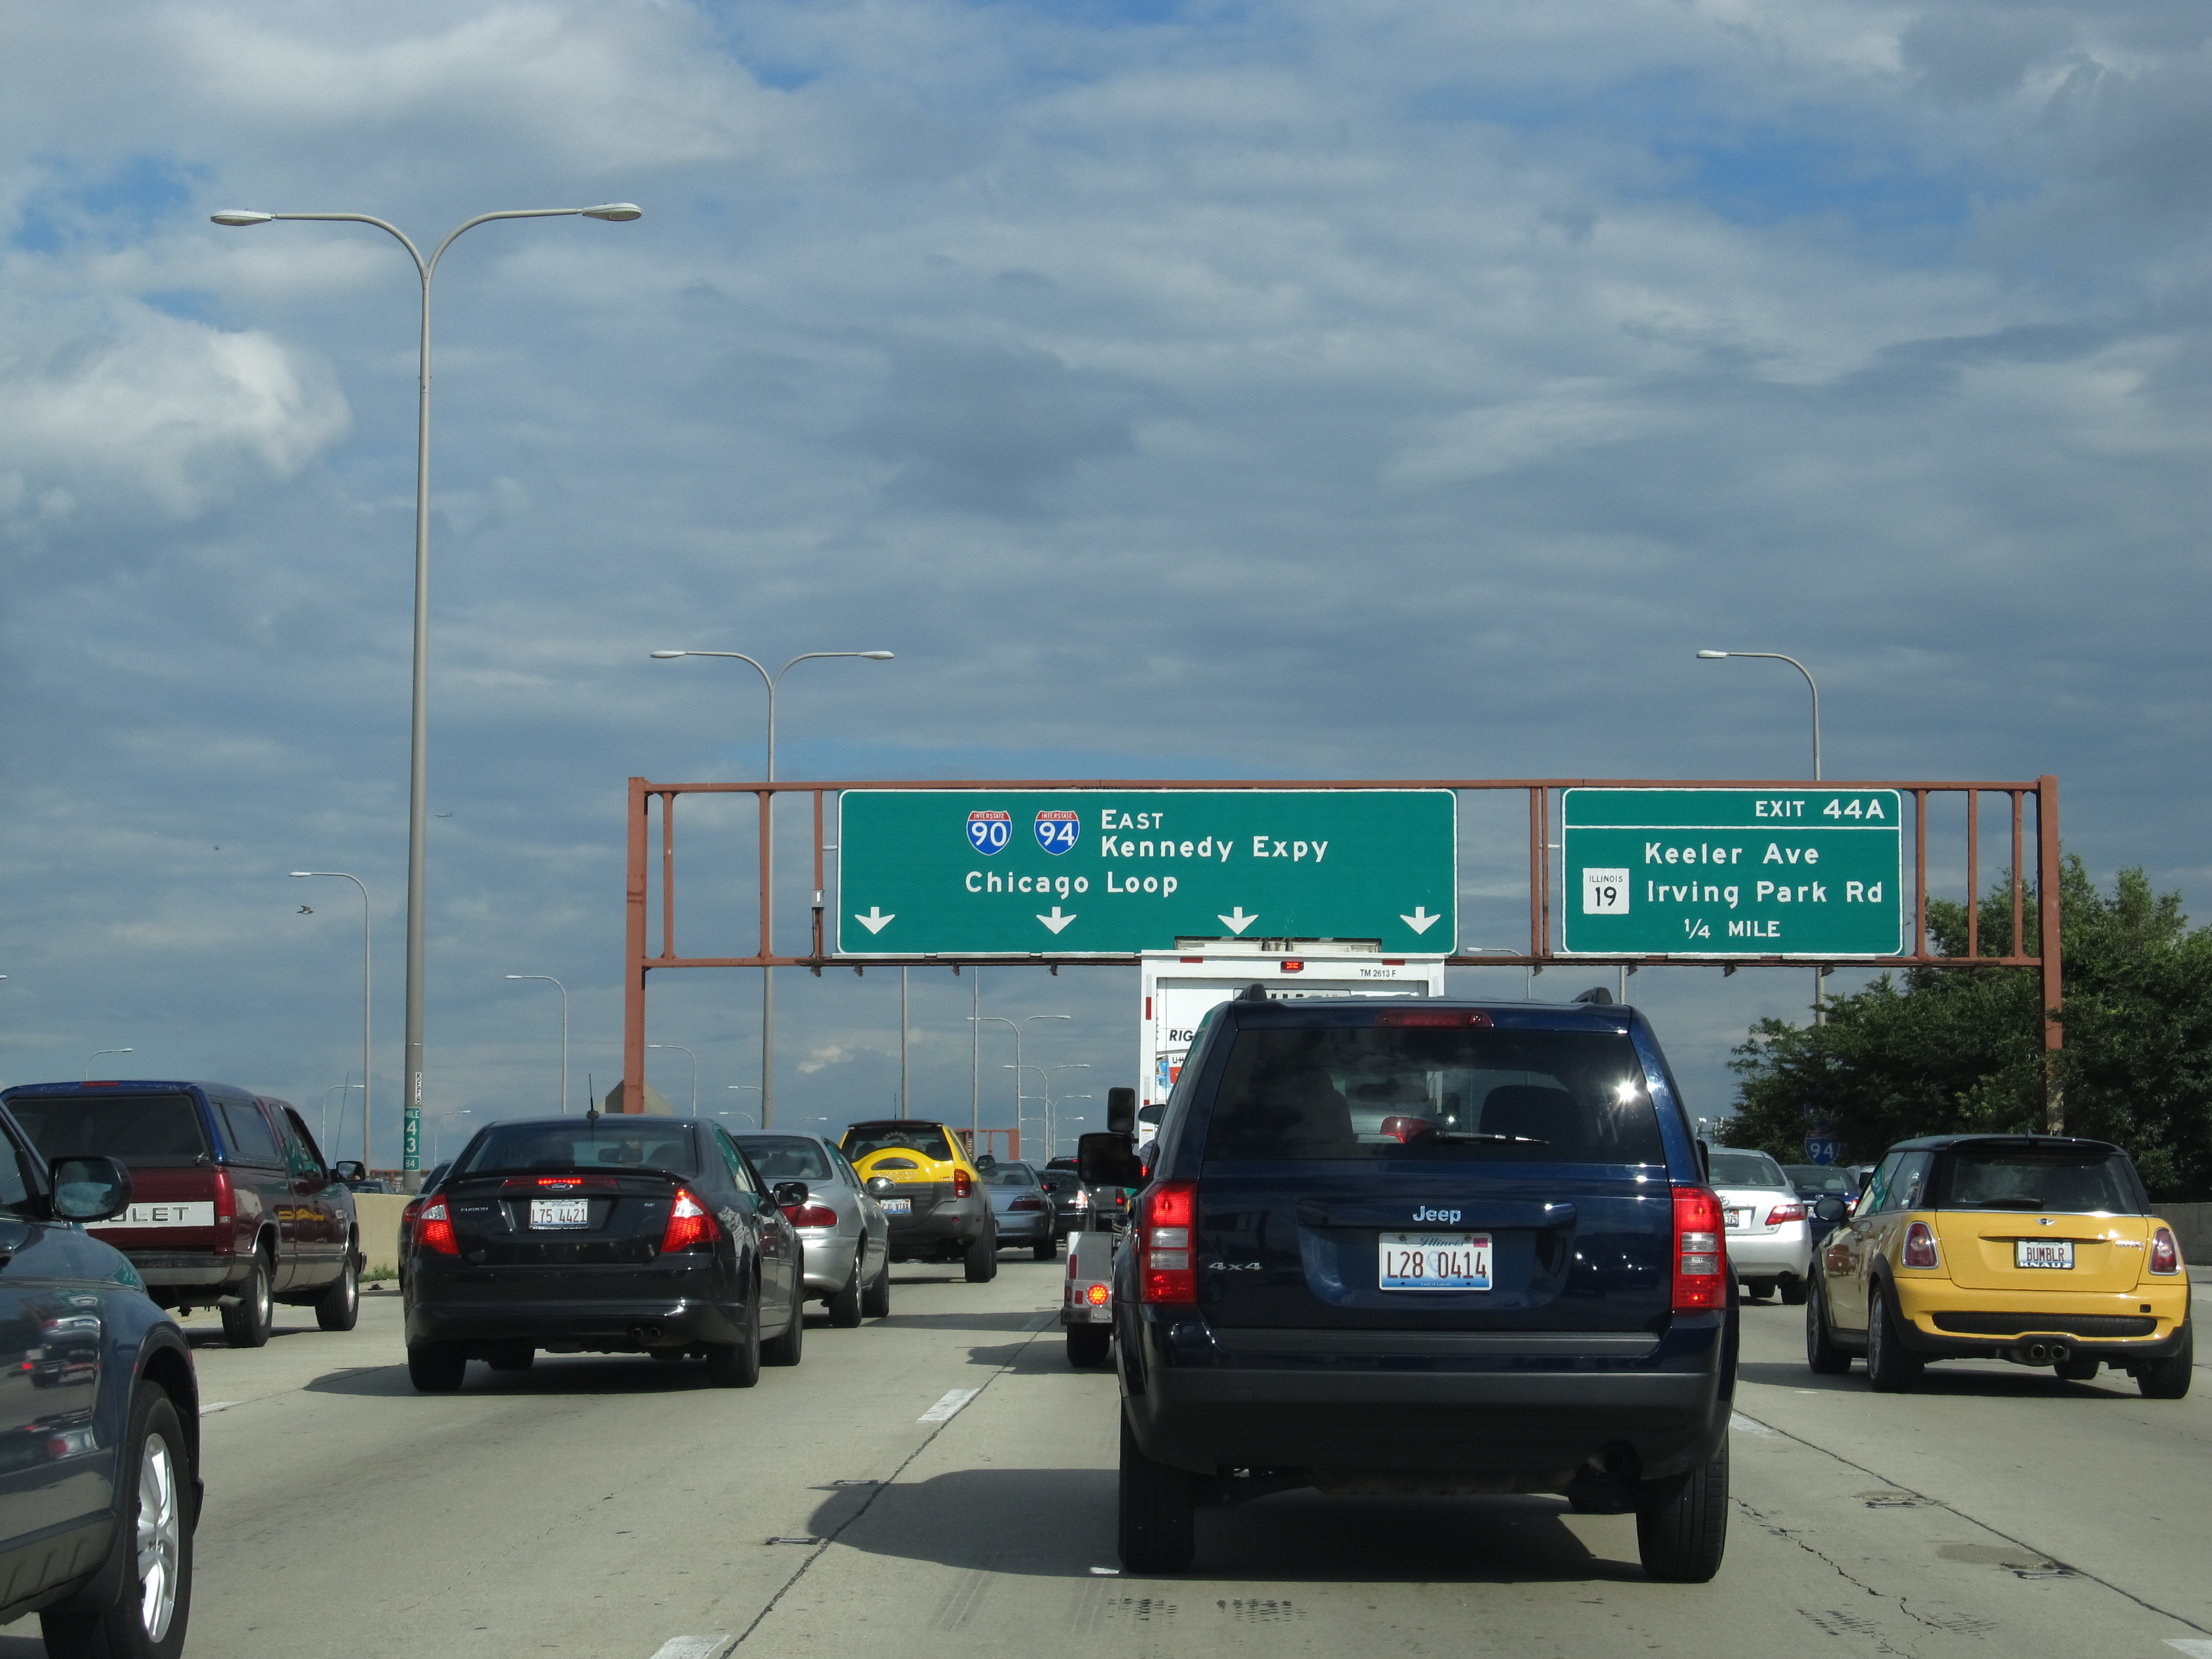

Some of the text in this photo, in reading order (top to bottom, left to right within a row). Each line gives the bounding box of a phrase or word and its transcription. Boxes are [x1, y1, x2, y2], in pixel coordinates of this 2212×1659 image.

[1101, 809, 1164, 829] EAST
[1755, 799, 1885, 820] EXIT 44A
[971, 822, 1007, 847] 90
[1039, 822, 1074, 847] 94
[1101, 836, 1328, 863] Kennedy Expy
[1645, 842, 1819, 864] Keeler Ave
[966, 870, 1178, 900] Chicago Loop
[1648, 880, 1882, 909] Irving Park Rd
[1595, 886, 1617, 907] 19
[1728, 921, 1781, 937] MILE
[405, 1110, 420, 1119] MILE
[1810, 1142, 1834, 1159] 94
[405, 1160, 415, 1168] 84
[531, 1208, 587, 1224] L75 4421
[1412, 1206, 1462, 1225] Jeep
[1408, 1236, 1464, 1248] Illinois
[2026, 1247, 2064, 1262] BUMBLR
[1208, 1262, 1262, 1271] 4x4
[1387, 1251, 1486, 1279] L28 0414
